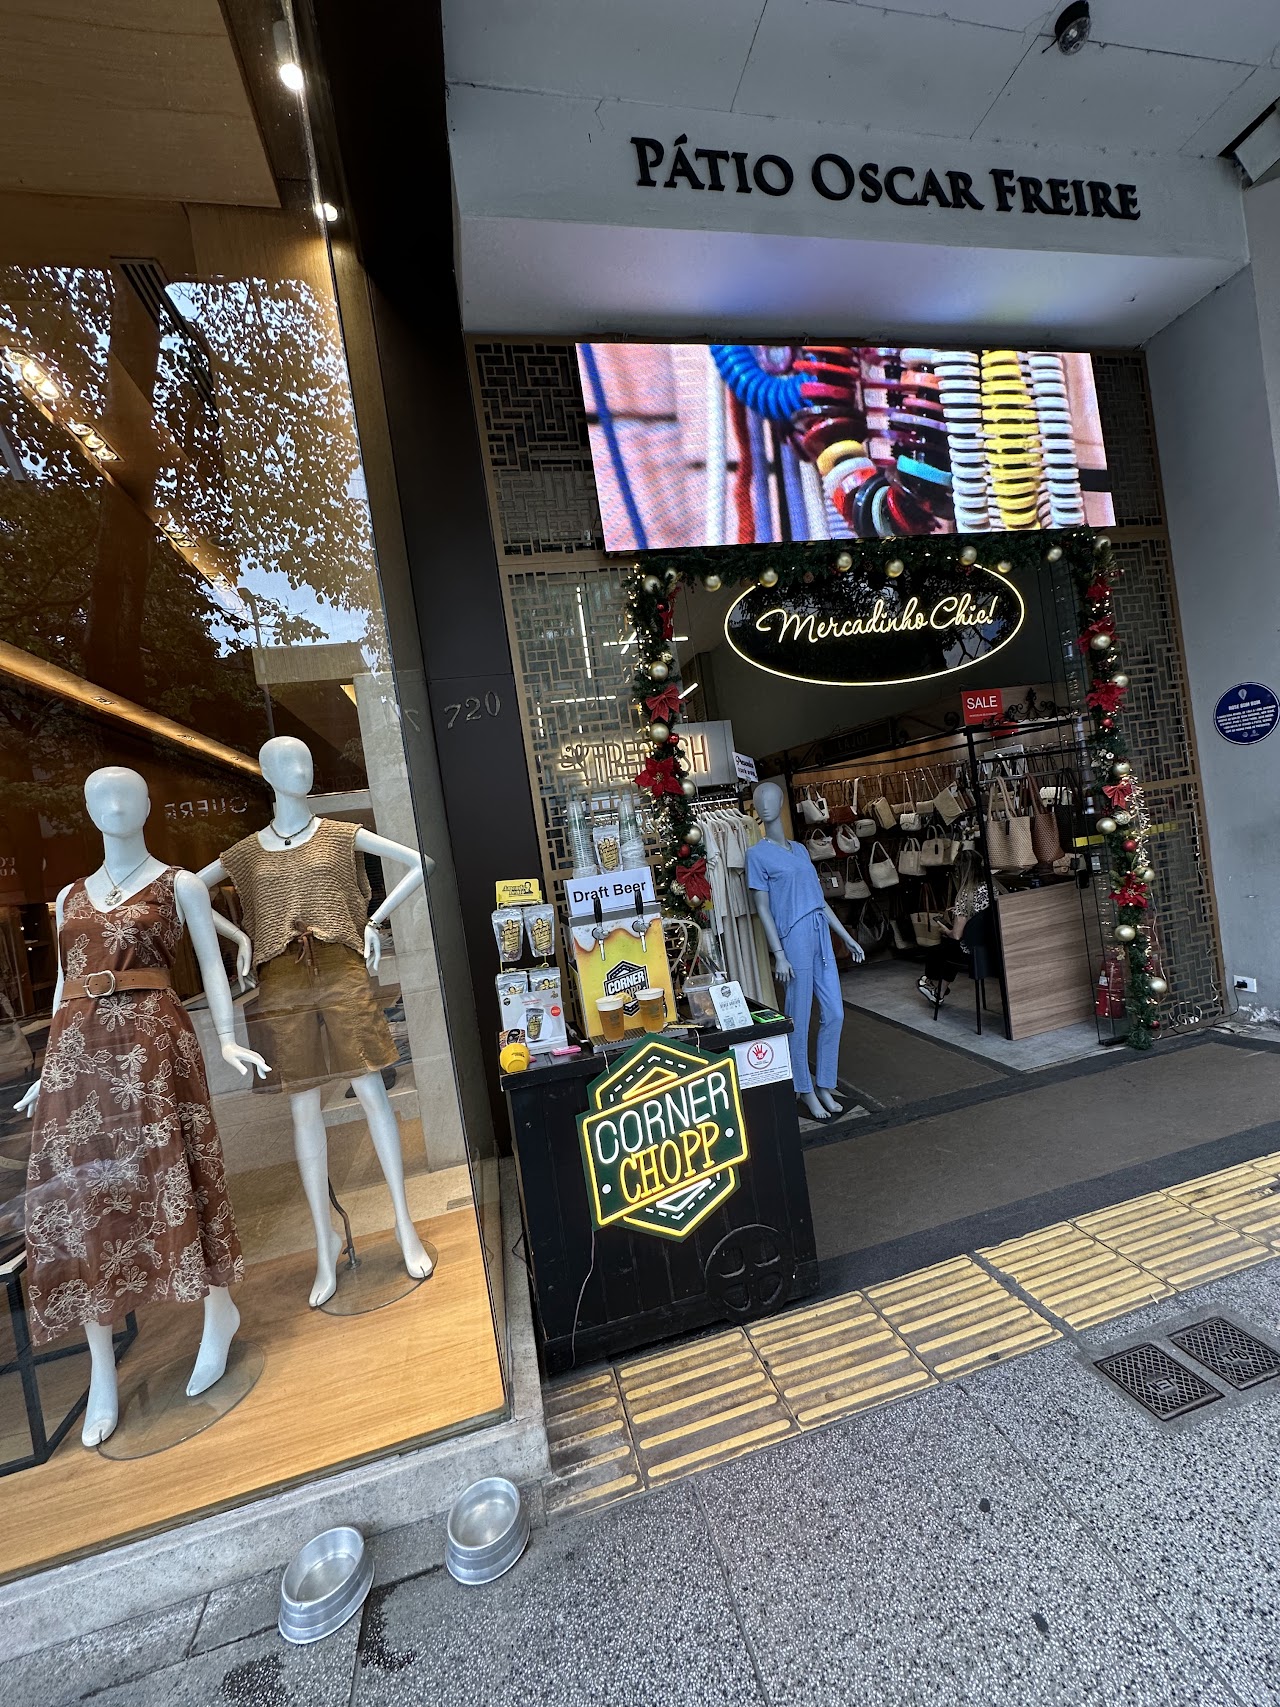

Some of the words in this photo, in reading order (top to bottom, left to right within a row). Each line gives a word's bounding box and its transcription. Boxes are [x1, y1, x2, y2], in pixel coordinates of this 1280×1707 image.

[630, 133, 794, 197] PÁTIO
[811, 153, 984, 211] OSCAR
[988, 168, 1142, 221] FREIRE
[755, 597, 928, 643] Mercadinho
[930, 593, 998, 630] Chic!
[444, 690, 501, 729] 720
[966, 695, 998, 710] SALE
[573, 886, 609, 903] Draft
[613, 881, 646, 896] Beer
[607, 971, 645, 994] CORNER
[595, 1071, 729, 1164] CORNER
[619, 1121, 720, 1204] CHOPP
